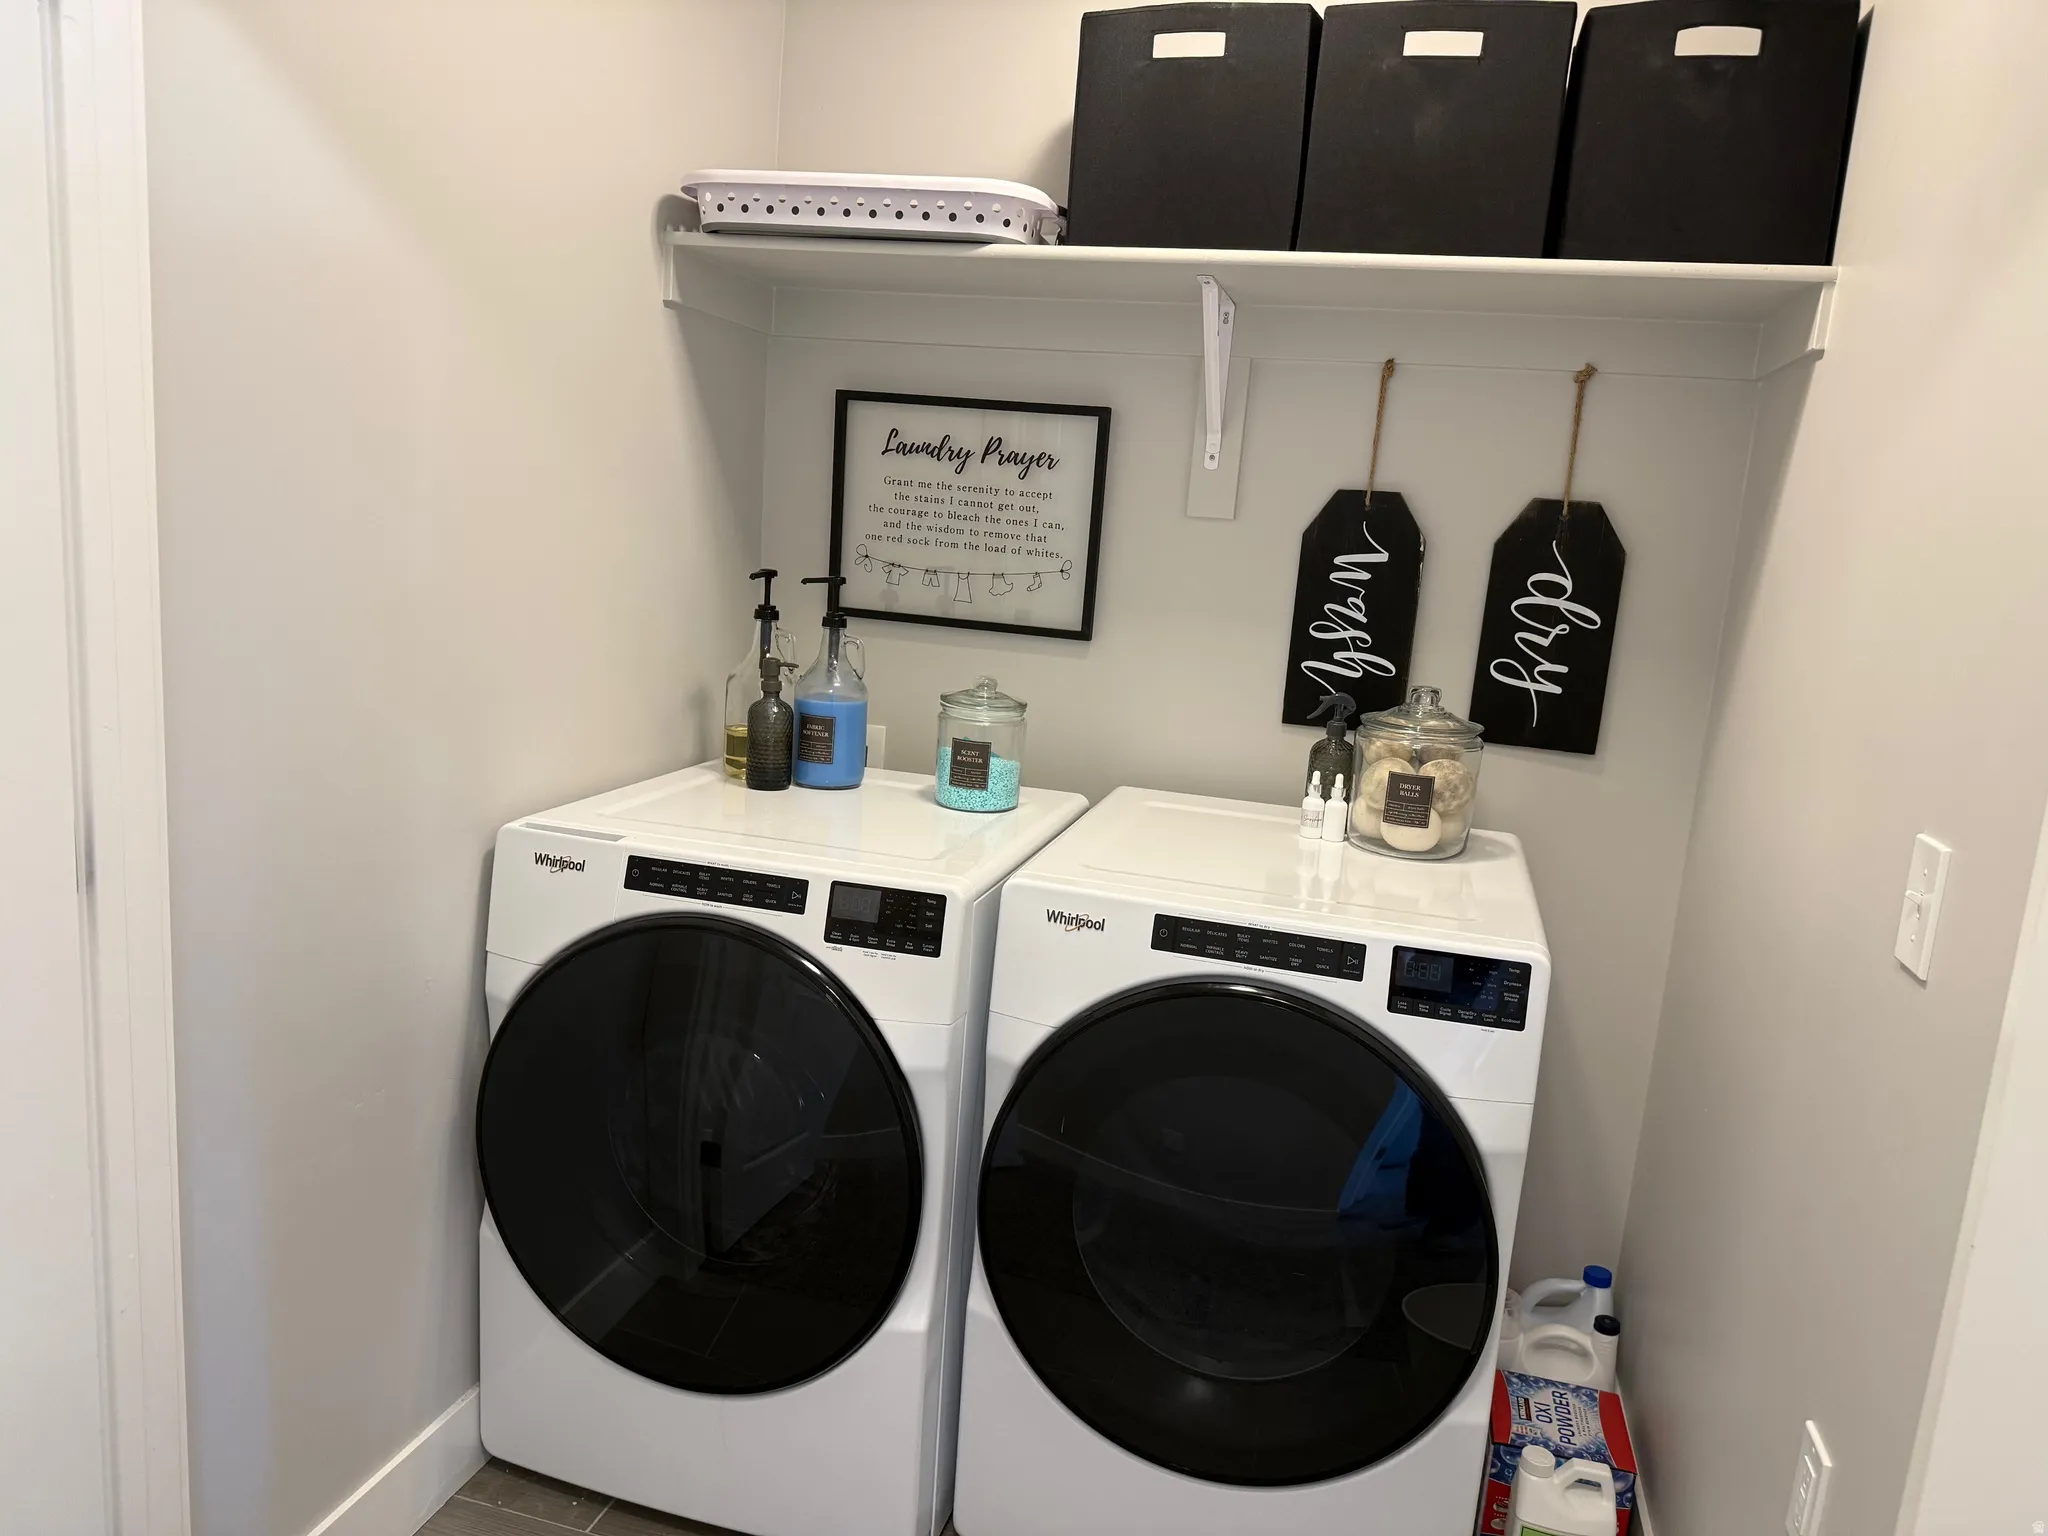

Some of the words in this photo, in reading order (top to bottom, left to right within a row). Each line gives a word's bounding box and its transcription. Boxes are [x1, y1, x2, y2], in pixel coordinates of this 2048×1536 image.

[881, 427, 976, 475] Laundry
[980, 435, 1060, 480] Prayer
[883, 475, 914, 487] Grant
[917, 480, 932, 489] me
[936, 480, 953, 490] the
[956, 484, 1000, 497] serenity
[1004, 487, 1015, 496] to
[1018, 490, 1053, 501] accept
[894, 491, 910, 501] the
[914, 494, 945, 504] stains
[949, 496, 954, 505] I
[957, 499, 994, 509] cannot
[997, 502, 1014, 512] get
[1018, 504, 1039, 514] out,
[868, 503, 885, 514] the
[887, 507, 929, 519] courage
[933, 509, 944, 519] to
[947, 510, 981, 523] bleach
[984, 514, 1002, 525] the
[1005, 518, 1029, 527] ones
[1033, 518, 1038, 528] I
[1042, 521, 1065, 531] can,
[883, 520, 902, 529] and
[906, 521, 922, 531] the
[926, 523, 965, 535] wisdom
[969, 528, 980, 537] to
[983, 530, 1021, 541] remove
[1025, 532, 1047, 543] that
[864, 533, 883, 541] one
[886, 534, 903, 543] red
[906, 536, 930, 546] sock
[934, 537, 959, 549] from
[963, 541, 980, 551] the
[984, 542, 1006, 554] load
[1010, 545, 1022, 555] of
[1026, 547, 1063, 559] whites.
[1301, 520, 1396, 694] wash
[1489, 540, 1601, 728] dry
[956, 755, 984, 764] BOOSTER
[960, 749, 980, 757] SCENT
[1399, 782, 1422, 791] DRYER
[1399, 790, 1420, 798] BALLS
[534, 851, 586, 873] Whirlpool
[1046, 908, 1106, 932] Whirlpool
[1206, 930, 1228, 938] DELICATES
[1205, 948, 1225, 956] CONTROL
[1533, 1401, 1553, 1424] OXI
[1551, 1390, 1577, 1446] POWDER
